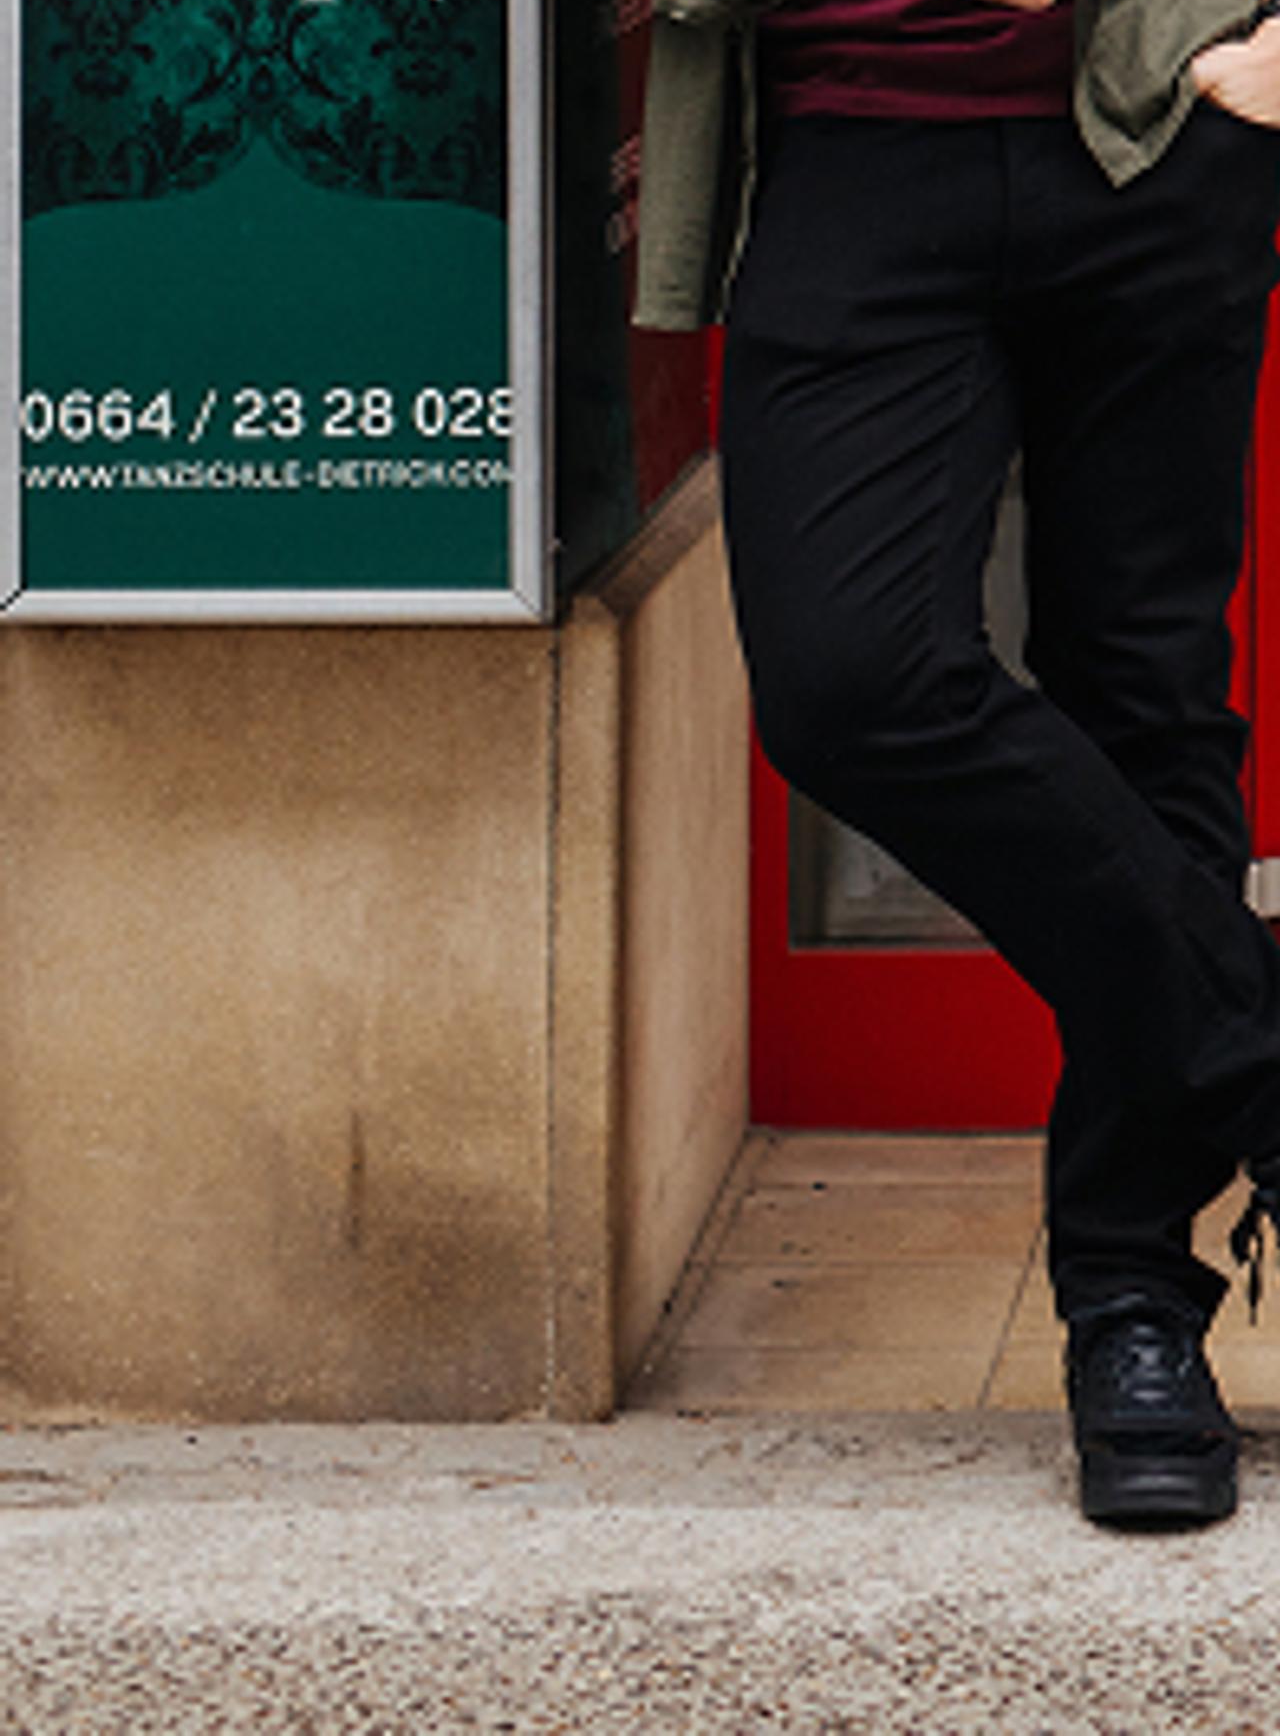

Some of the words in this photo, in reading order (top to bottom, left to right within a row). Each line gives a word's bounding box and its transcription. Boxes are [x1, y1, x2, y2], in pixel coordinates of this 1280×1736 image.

[22, 388, 174, 442] 0664
[186, 389, 218, 444] /
[232, 387, 304, 438] 23
[323, 387, 394, 437] 28
